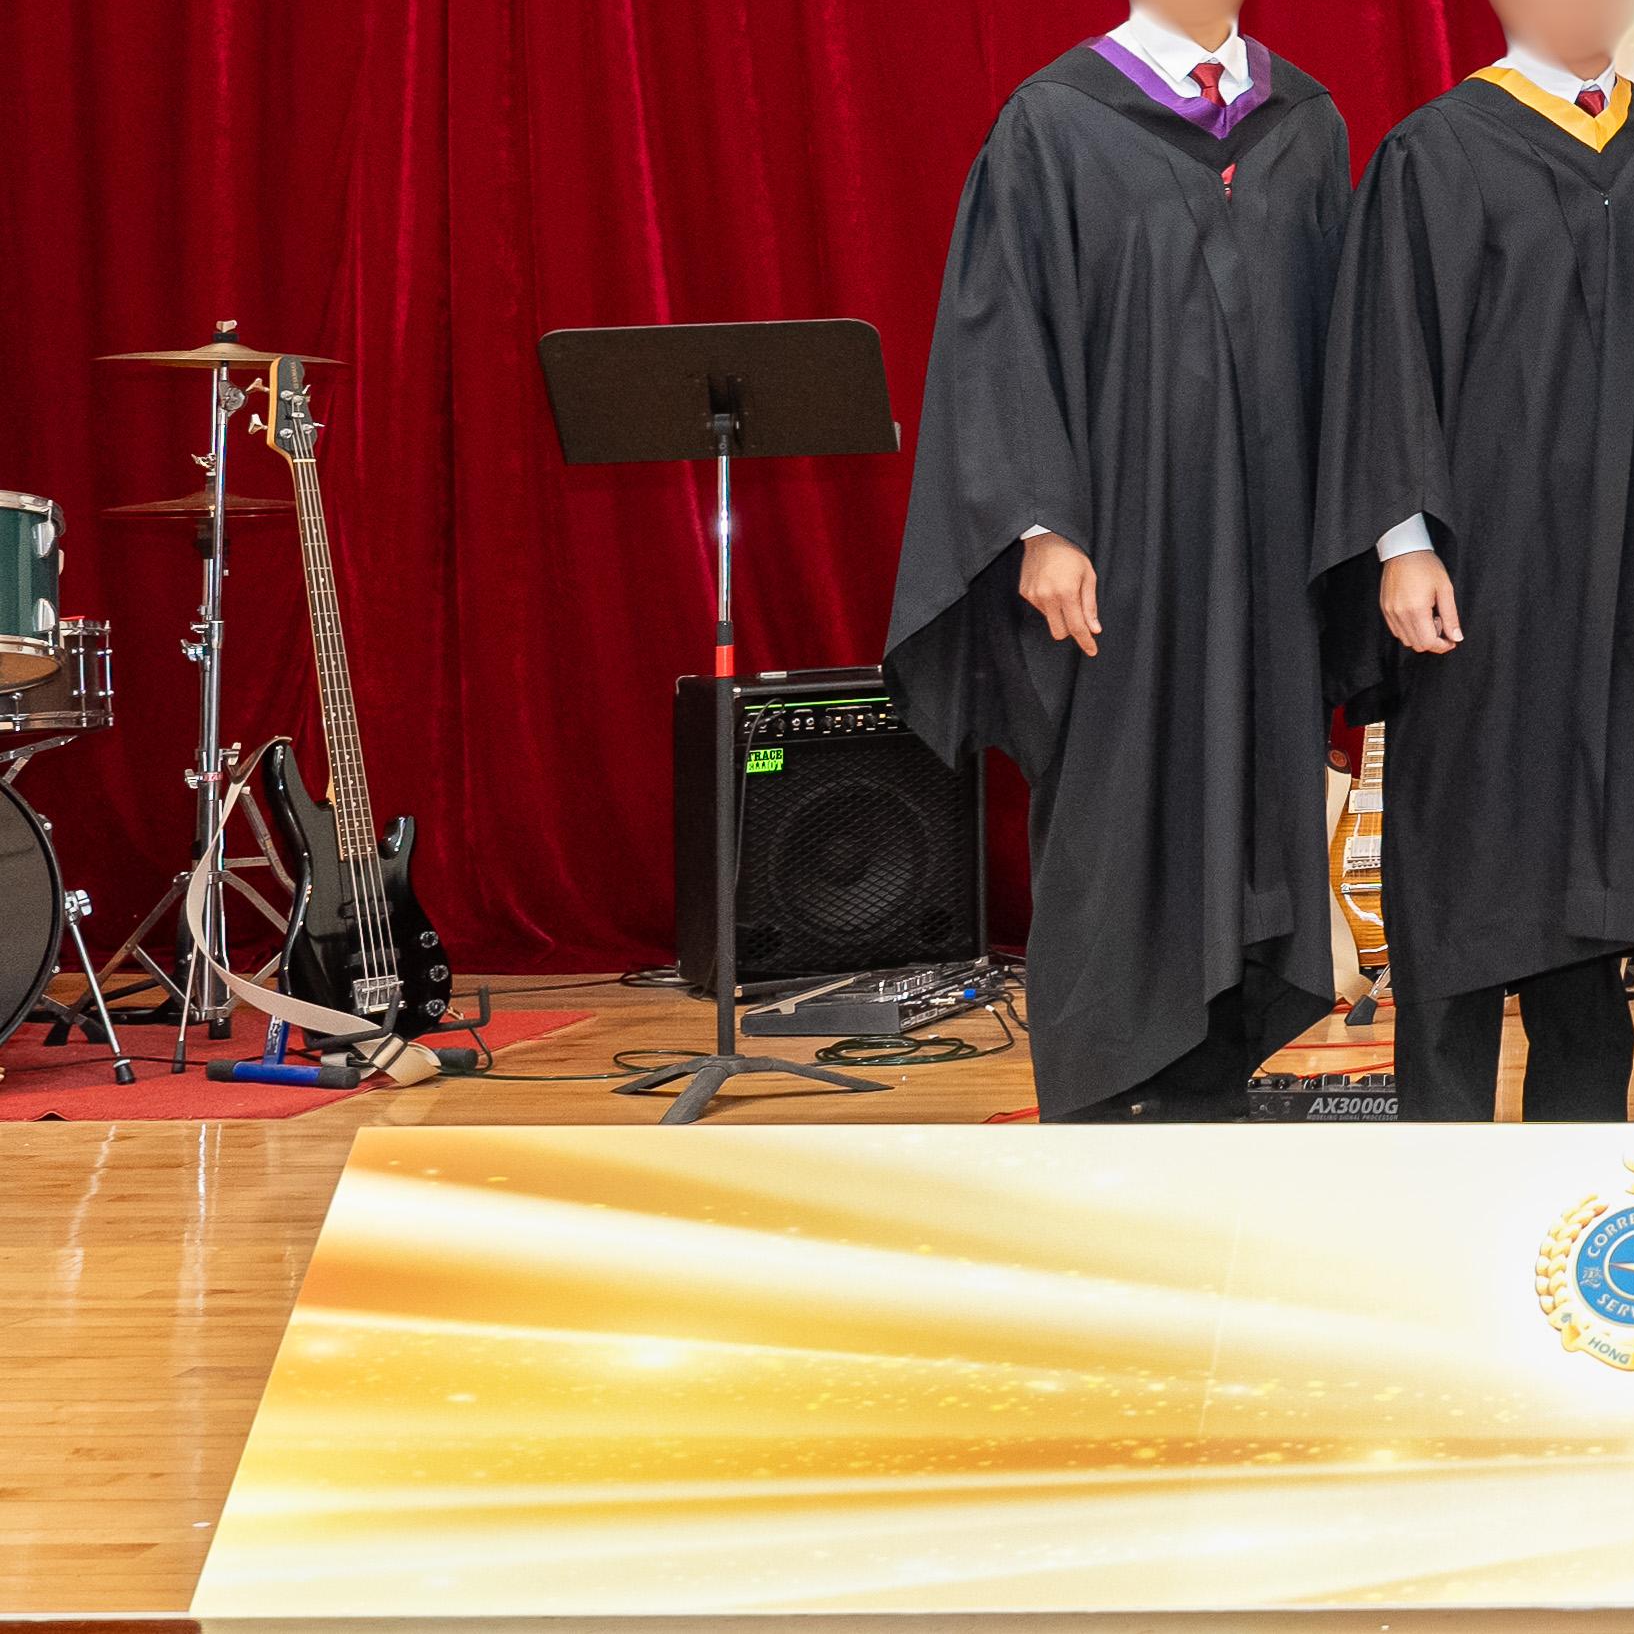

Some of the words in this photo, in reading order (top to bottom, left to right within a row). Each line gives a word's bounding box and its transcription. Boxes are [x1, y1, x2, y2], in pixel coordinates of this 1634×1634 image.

[747, 749, 783, 762] TRACE
[1308, 1097, 1399, 1115] AX3000G
[1588, 1336, 1630, 1365] HONG
